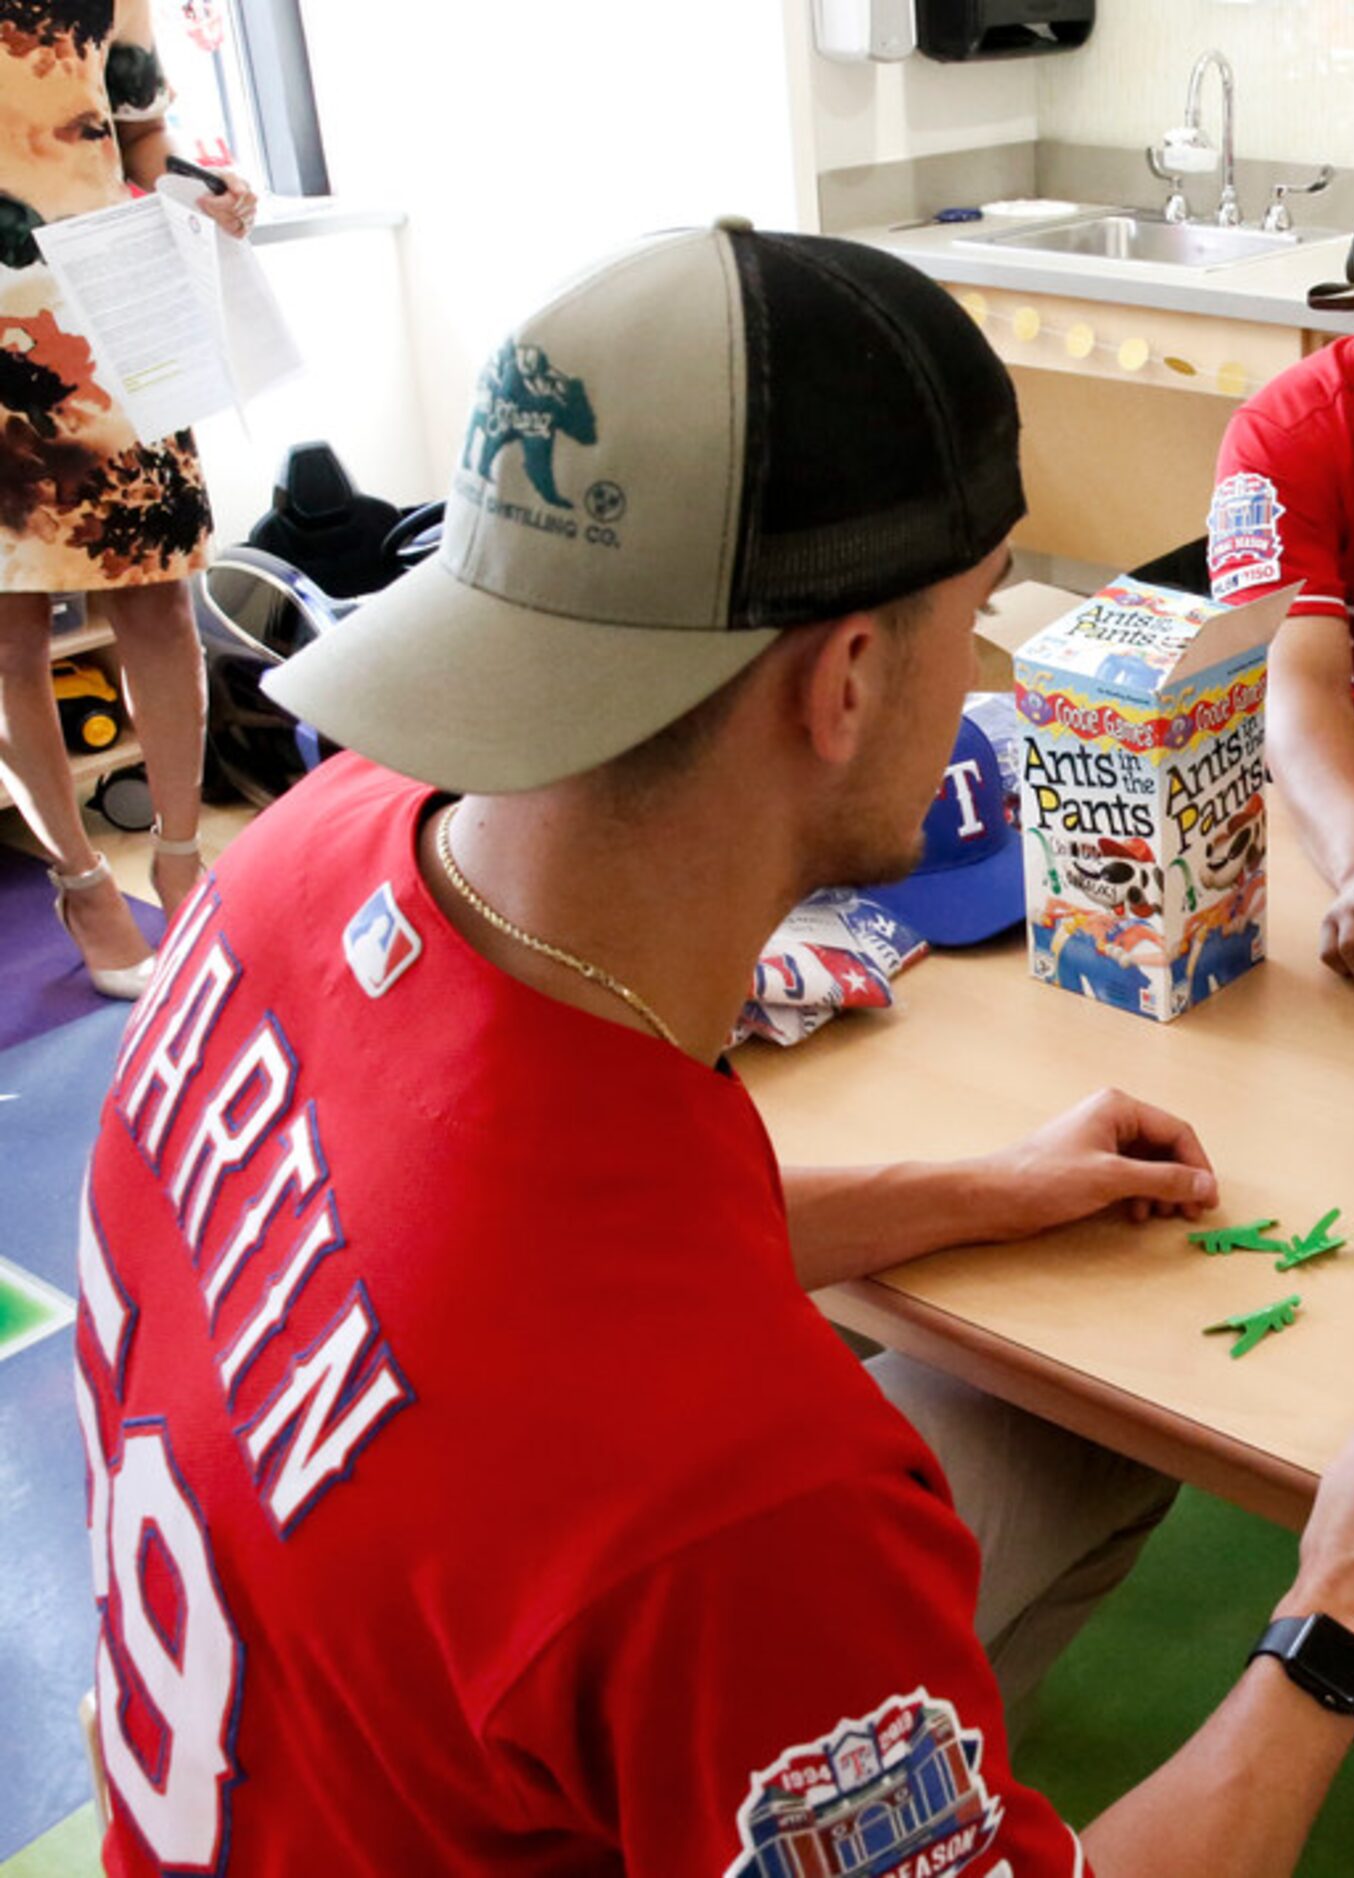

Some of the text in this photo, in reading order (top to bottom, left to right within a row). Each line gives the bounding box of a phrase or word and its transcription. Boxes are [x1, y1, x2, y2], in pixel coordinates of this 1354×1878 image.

[585, 525, 621, 549] CO.
[1066, 620, 1157, 646] Pants
[1077, 605, 1153, 628] Ants
[1024, 737, 1142, 788] Ants in
[1122, 772, 1155, 794] the
[1165, 728, 1244, 817] Ants
[1031, 784, 1155, 837] Pants
[1173, 757, 1264, 852] Pants
[114, 870, 417, 1542] MARTIN
[782, 1764, 832, 1790] 1994
[884, 1824, 977, 1878] EASON
